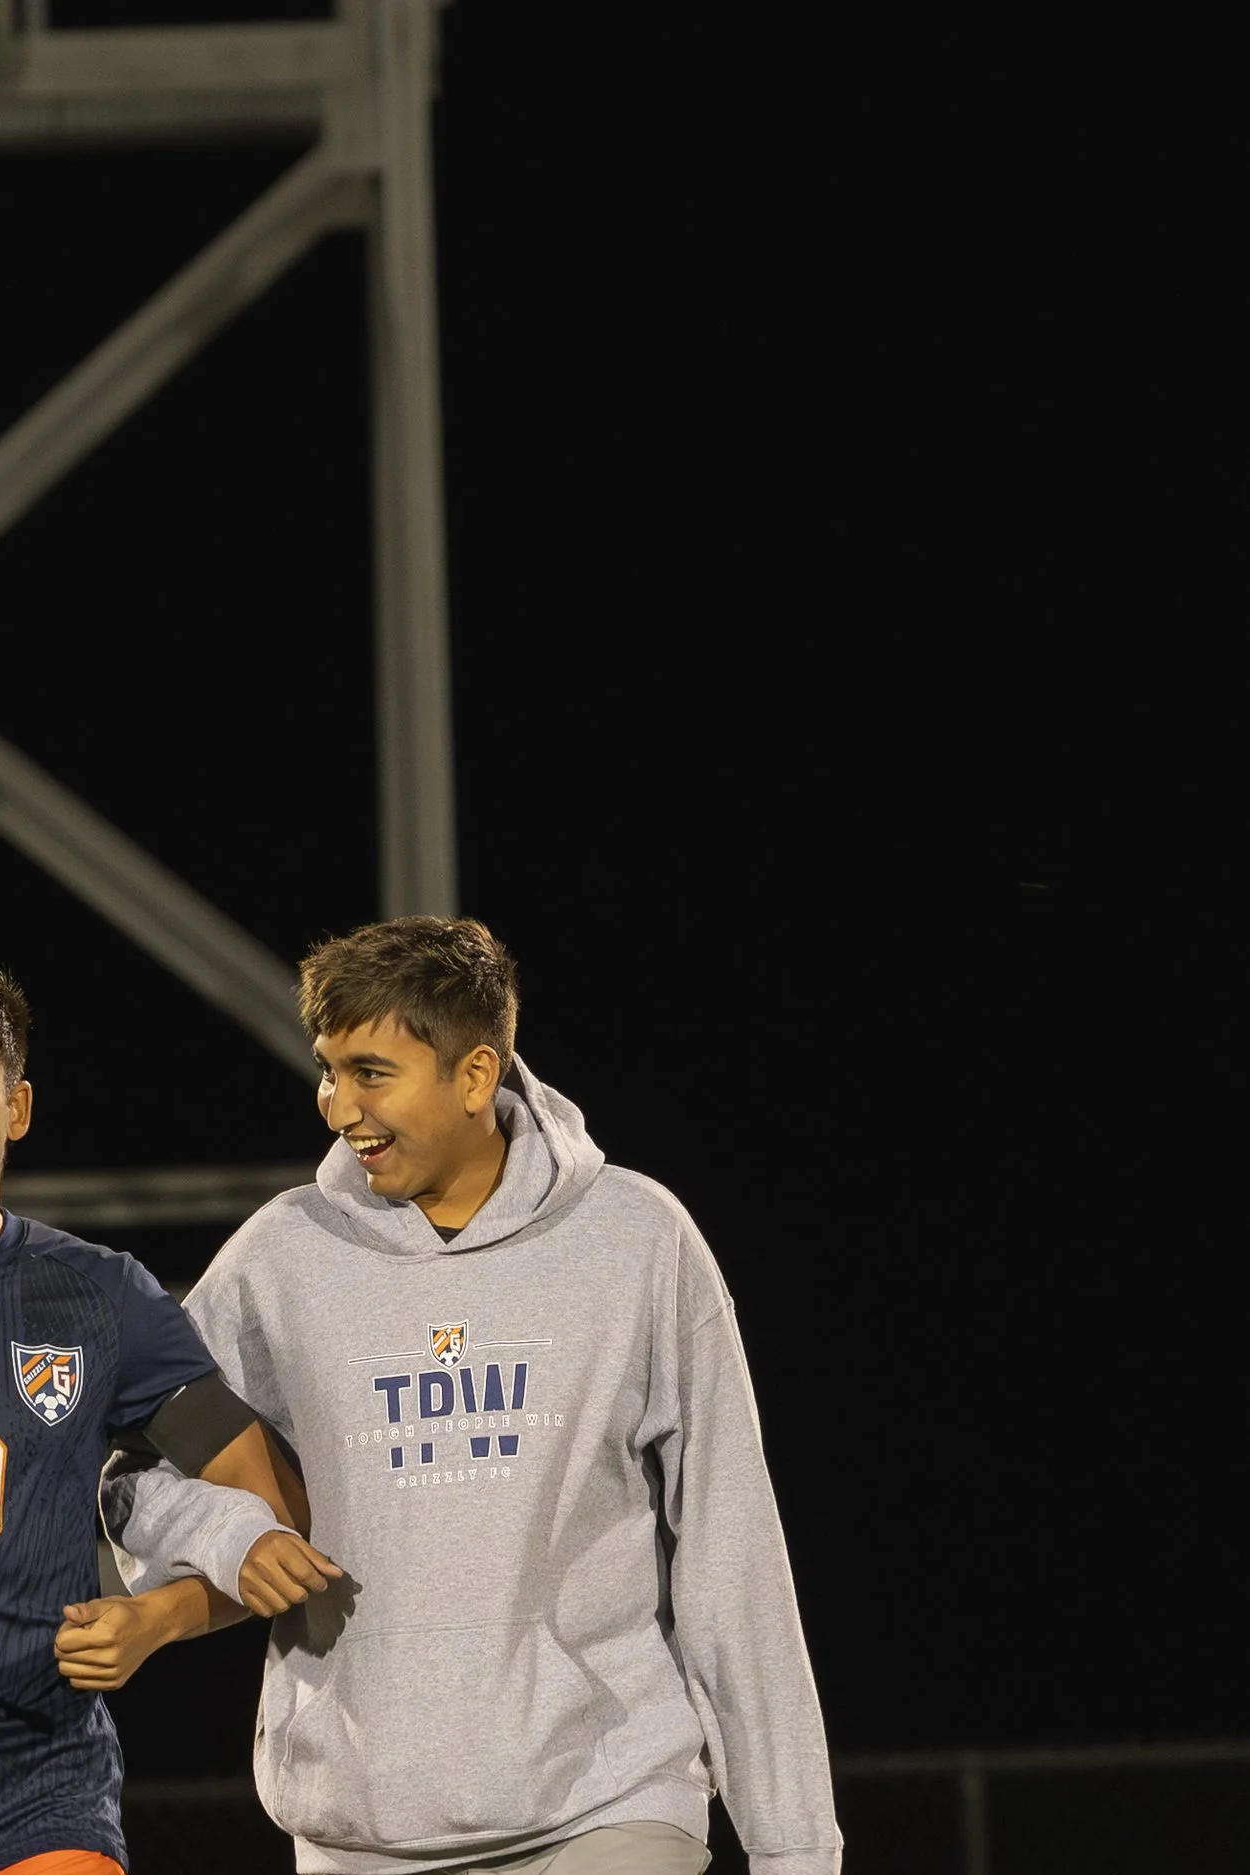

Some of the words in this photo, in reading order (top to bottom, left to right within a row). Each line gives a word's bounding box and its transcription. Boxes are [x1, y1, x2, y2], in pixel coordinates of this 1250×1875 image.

[52, 1364, 71, 1398] G
[345, 1425, 415, 1448] TOUGH
[431, 1415, 510, 1434] PEOPLE
[526, 1413, 565, 1428] WIN
[396, 1468, 478, 1489] GRIZZLY
[490, 1465, 512, 1479] FC
